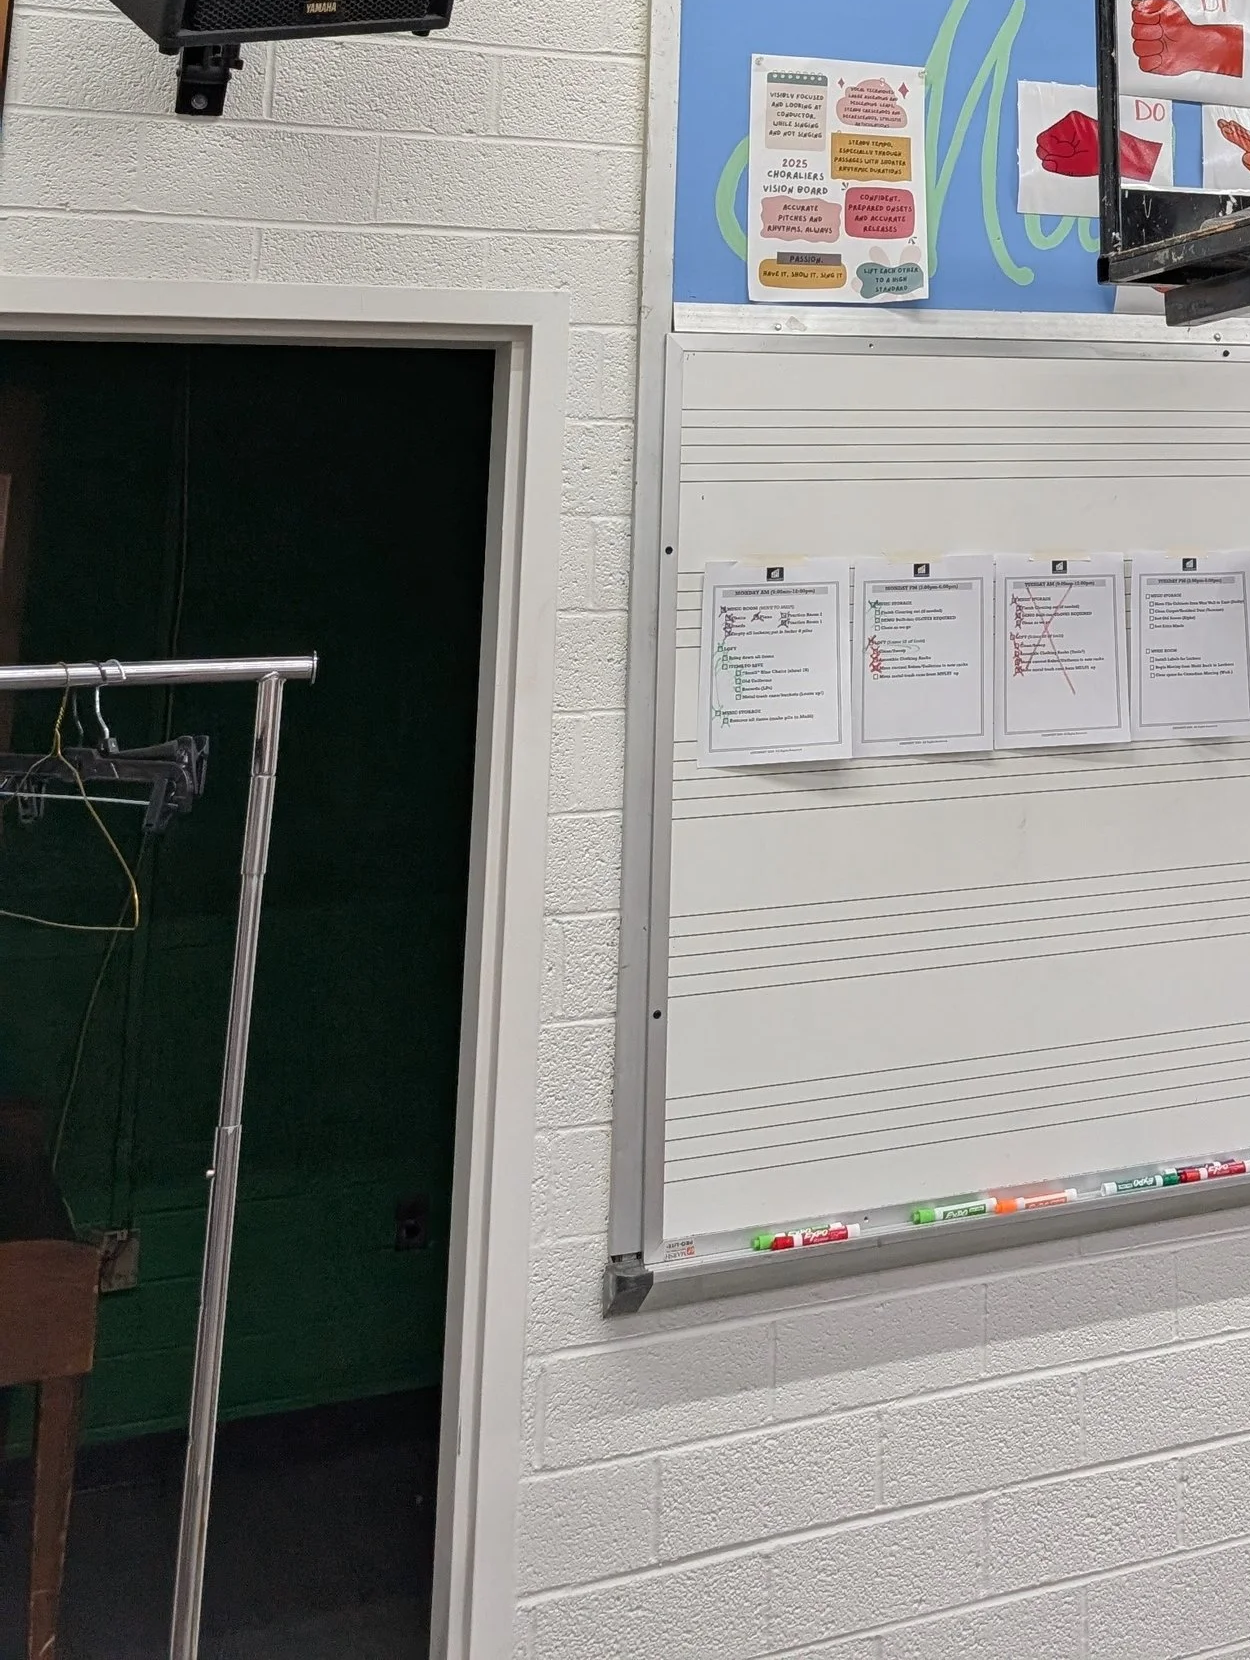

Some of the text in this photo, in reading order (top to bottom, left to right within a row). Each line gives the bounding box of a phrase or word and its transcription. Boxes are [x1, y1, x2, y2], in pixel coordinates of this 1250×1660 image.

[307, 2, 336, 13] YAMAHA
[1135, 99, 1167, 124] DO
[782, 159, 808, 169] 2025
[767, 170, 824, 180] CHORALIERS
[763, 184, 828, 195] VISION BOARD
[782, 204, 819, 212] ACCURATE
